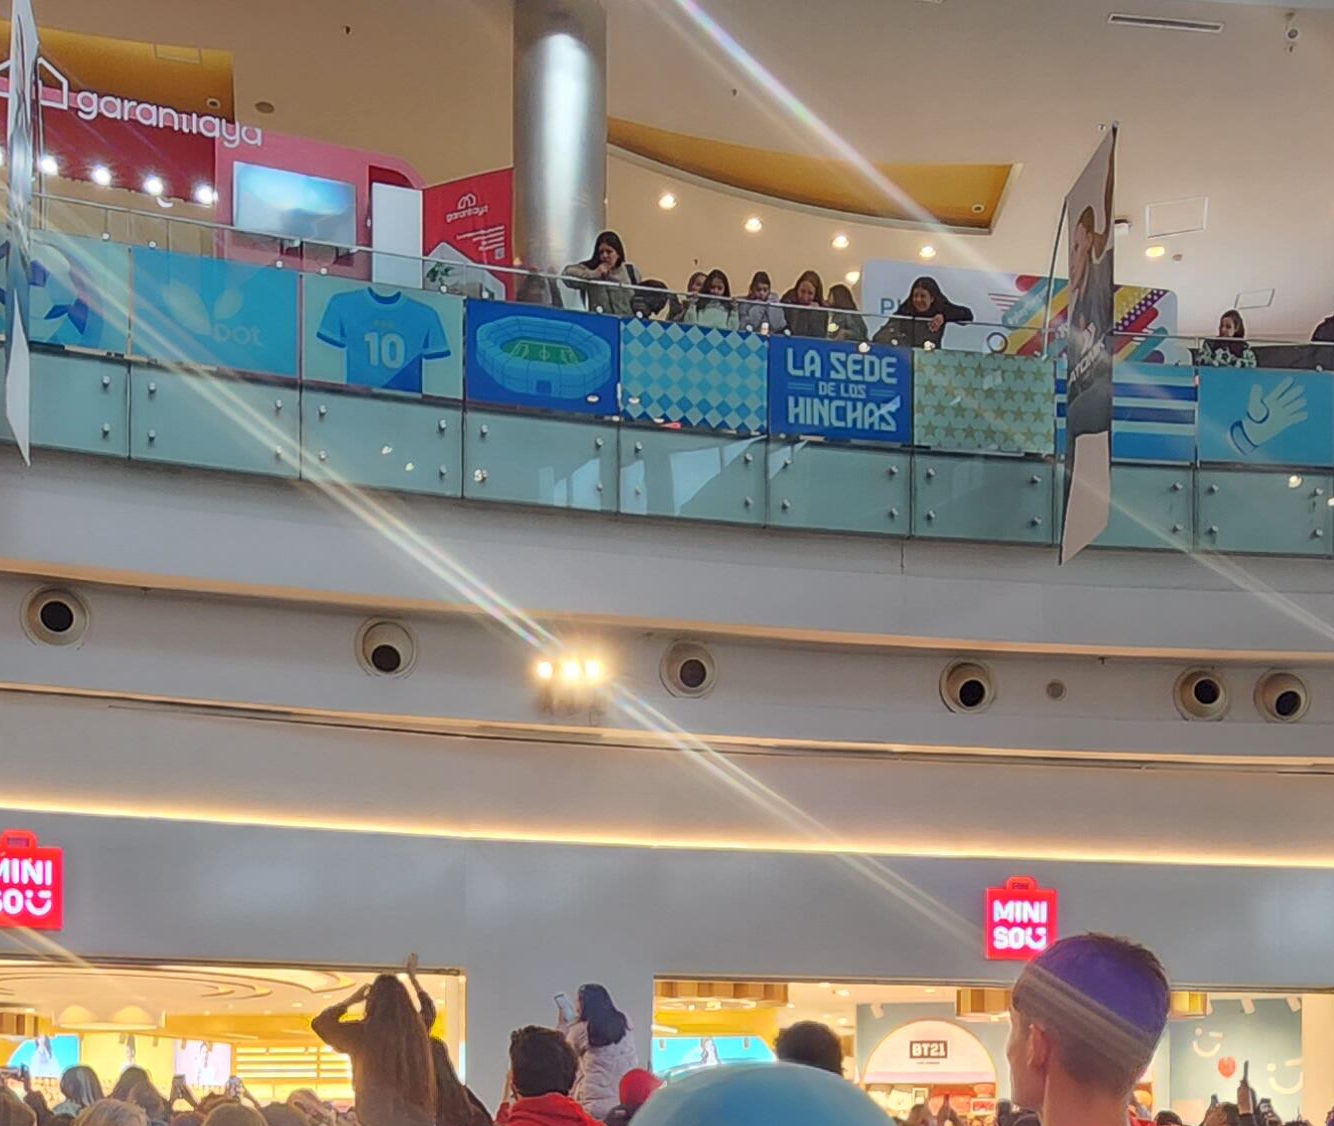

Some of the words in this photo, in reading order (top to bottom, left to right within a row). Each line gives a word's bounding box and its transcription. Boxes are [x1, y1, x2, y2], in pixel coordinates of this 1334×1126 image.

[363, 332, 405, 369] 10
[786, 346, 822, 378] LA
[829, 351, 898, 385] SEDE
[818, 381, 836, 397] DE
[840, 382, 867, 399] LOS
[787, 395, 899, 432] HINCHAS
[993, 900, 1047, 923] MINI
[911, 1042, 946, 1057] BT21
